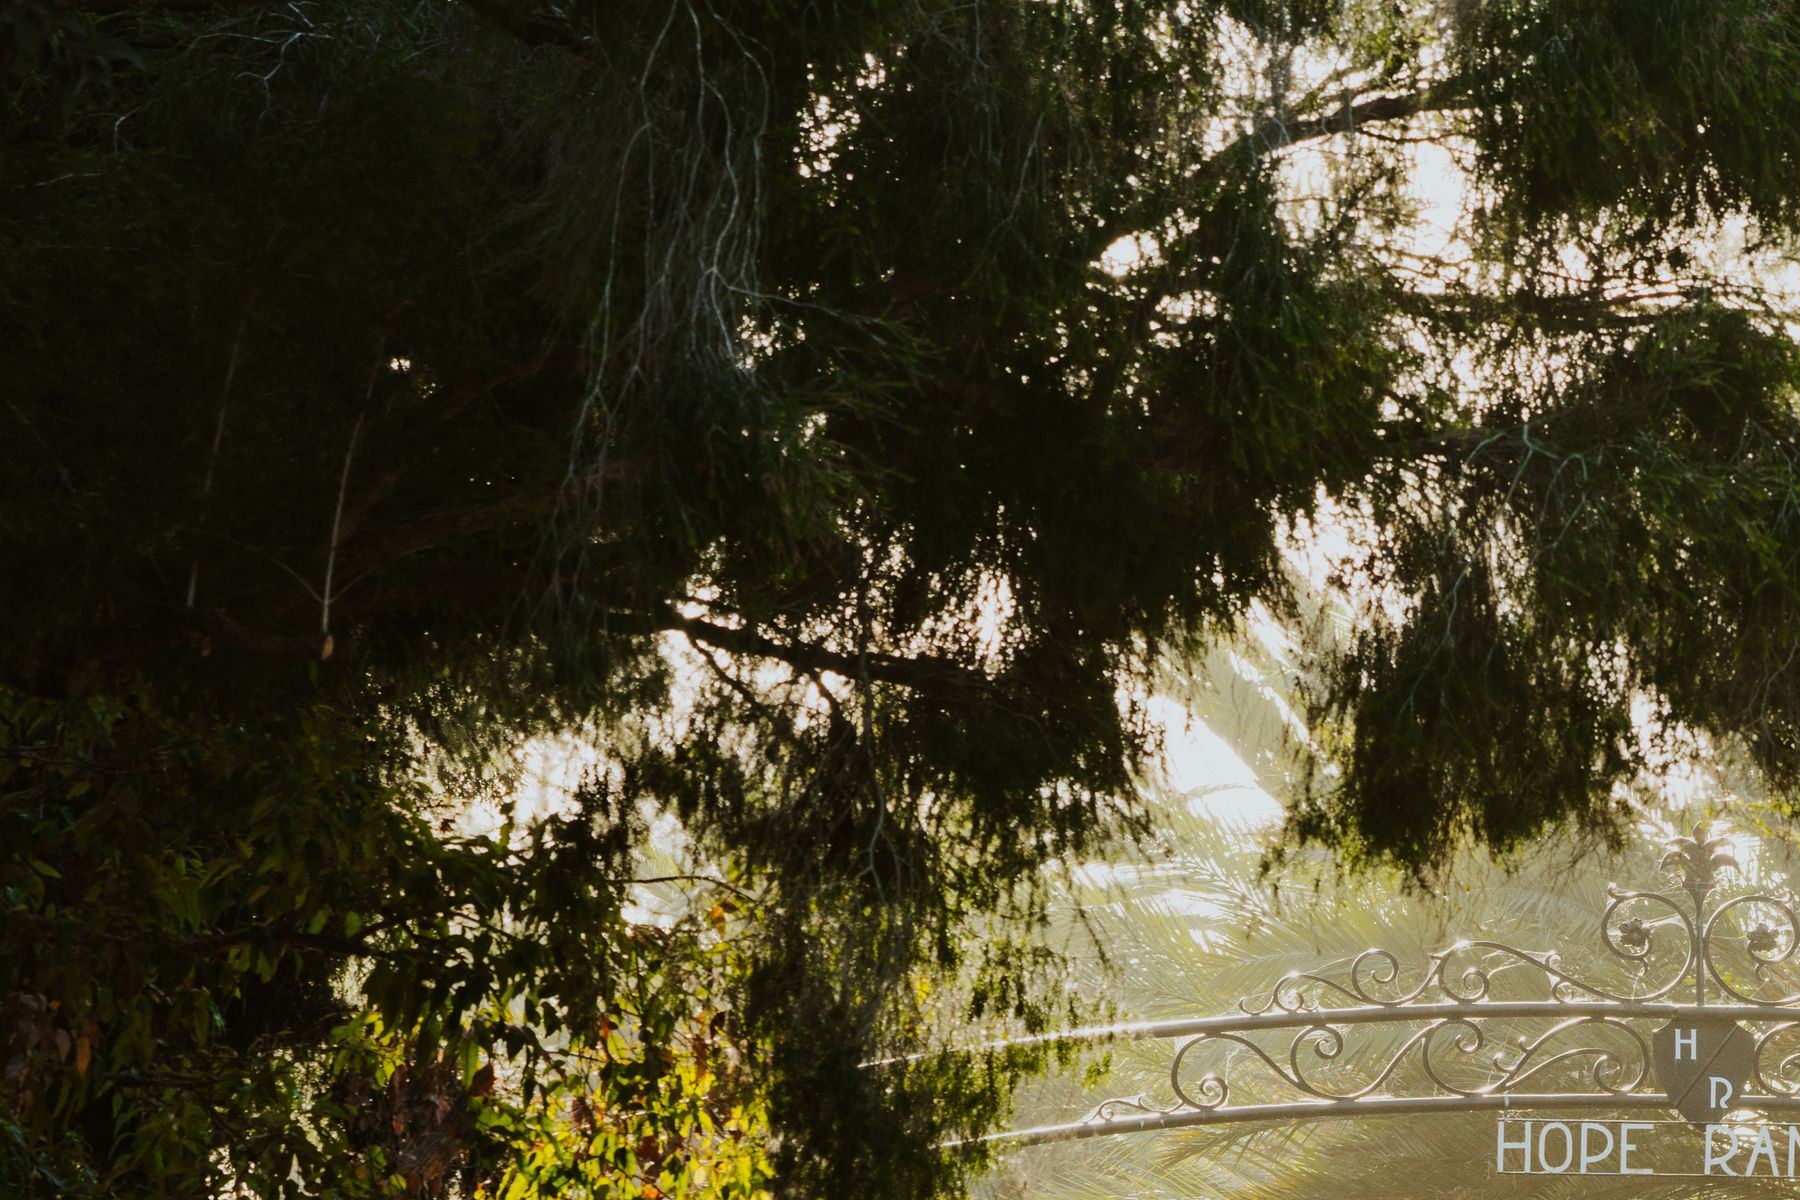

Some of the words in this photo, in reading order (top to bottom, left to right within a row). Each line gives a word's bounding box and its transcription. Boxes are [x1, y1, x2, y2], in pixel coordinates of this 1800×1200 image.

[1674, 1028, 1697, 1060] H
[1709, 1076, 1733, 1109] R
[1497, 1120, 1655, 1175] HOPE
